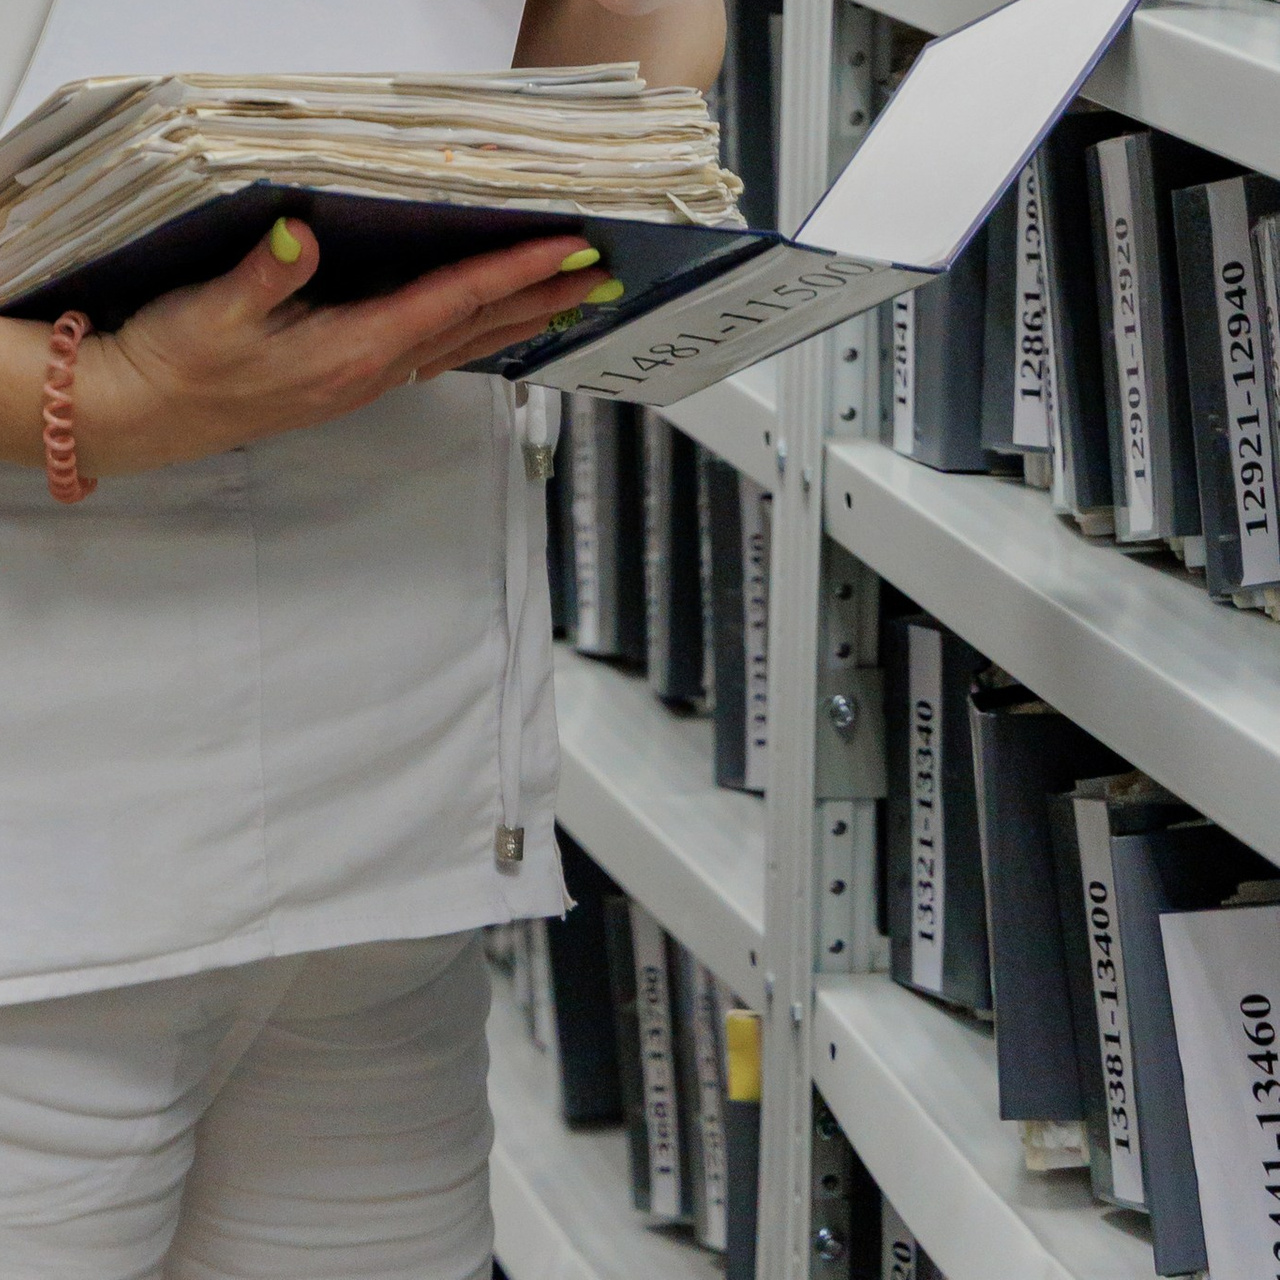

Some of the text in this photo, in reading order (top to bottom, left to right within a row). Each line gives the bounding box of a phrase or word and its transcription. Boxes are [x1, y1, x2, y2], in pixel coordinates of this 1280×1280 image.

[576, 260, 874, 396] 11481-11500
[1115, 217, 1148, 483] 12901-12920
[1222, 261, 1269, 537] 12921-12940
[916, 700, 936, 945] 13321-13340
[1089, 879, 1131, 1155] 13381-13400
